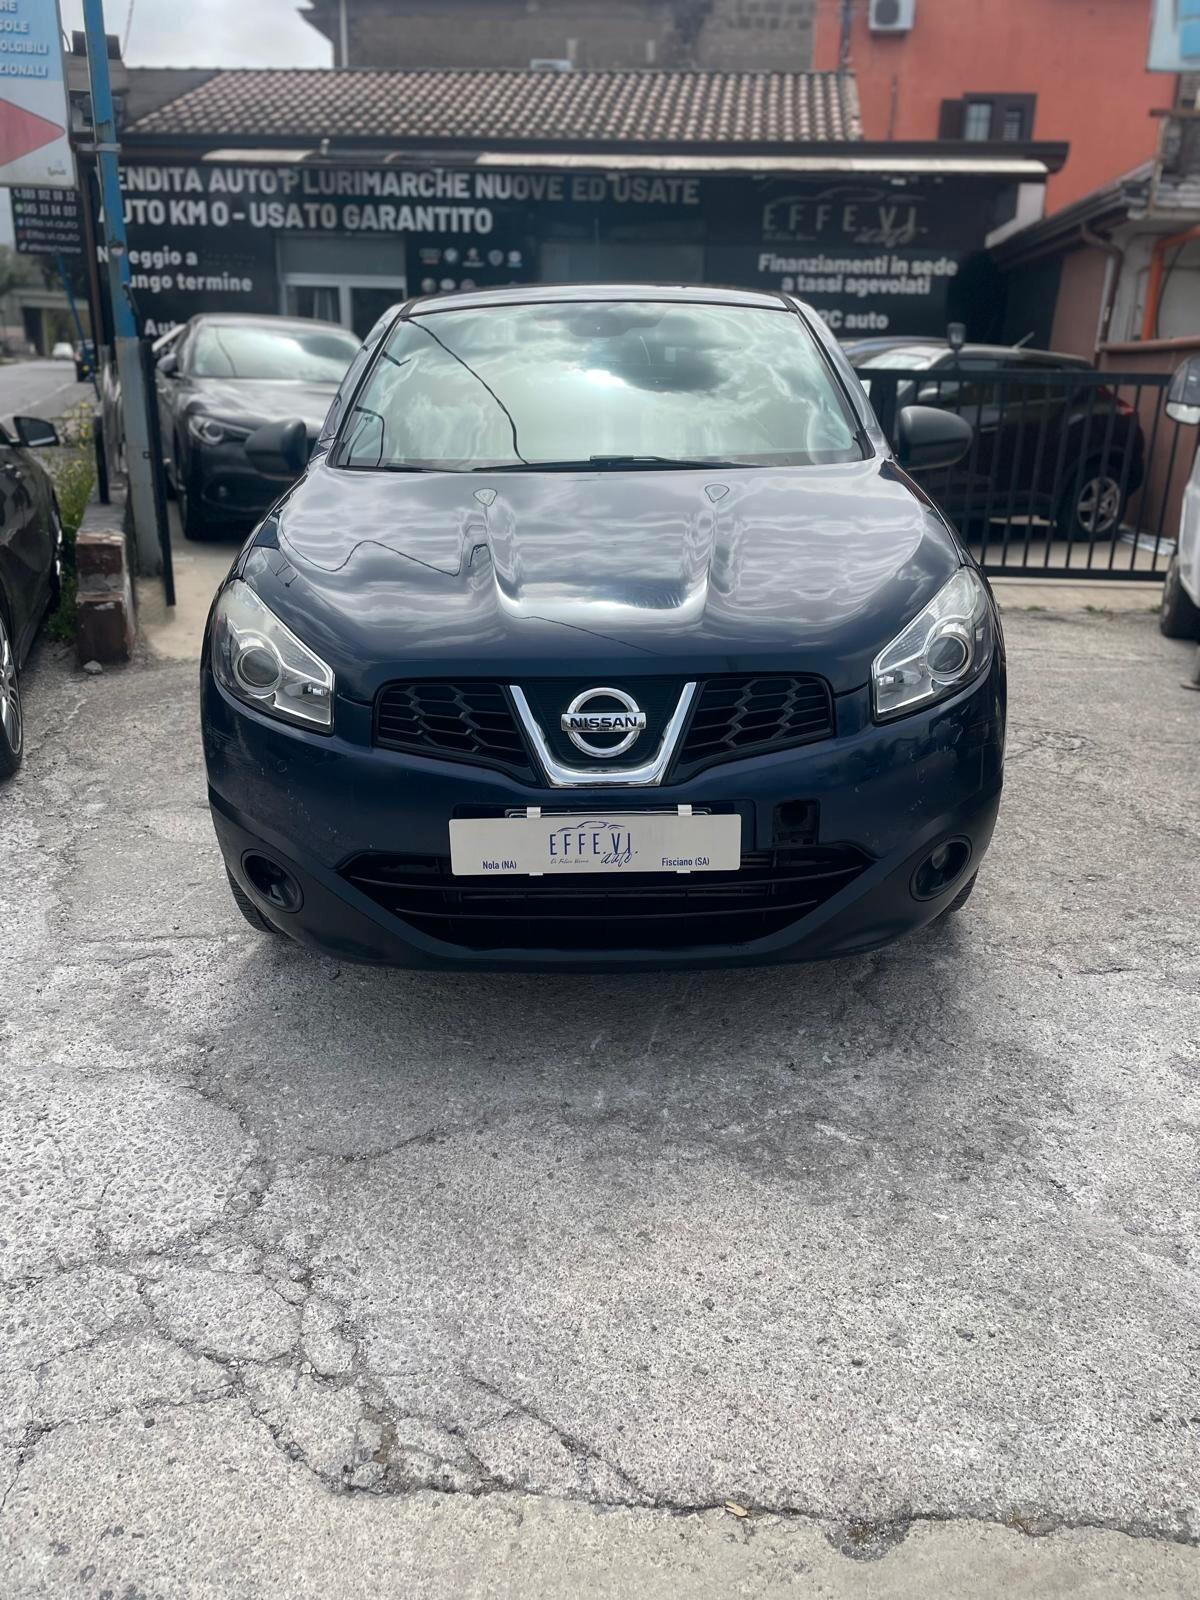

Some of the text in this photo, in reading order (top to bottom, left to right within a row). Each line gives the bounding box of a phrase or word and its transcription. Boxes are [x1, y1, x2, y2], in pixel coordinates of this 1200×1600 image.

[209, 169, 277, 194] AUTO
[475, 173, 563, 200] NUOVE
[572, 175, 606, 201] ED
[613, 175, 699, 204] USATE
[98, 199, 165, 224] UTO
[250, 203, 337, 229] USATO
[342, 204, 493, 233] GARANTITO
[96, 246, 182, 269] Neggio
[185, 252, 198, 266] a
[758, 254, 958, 276] Finanziamenti in sede
[129, 272, 253, 293] ungo termine
[781, 275, 931, 297] a tassi agevolati
[845, 311, 889, 330] auto
[570, 716, 637, 728] NISSAN
[482, 860, 517, 870] Nola (NA)
[661, 857, 710, 867] Fisciano (SA)
